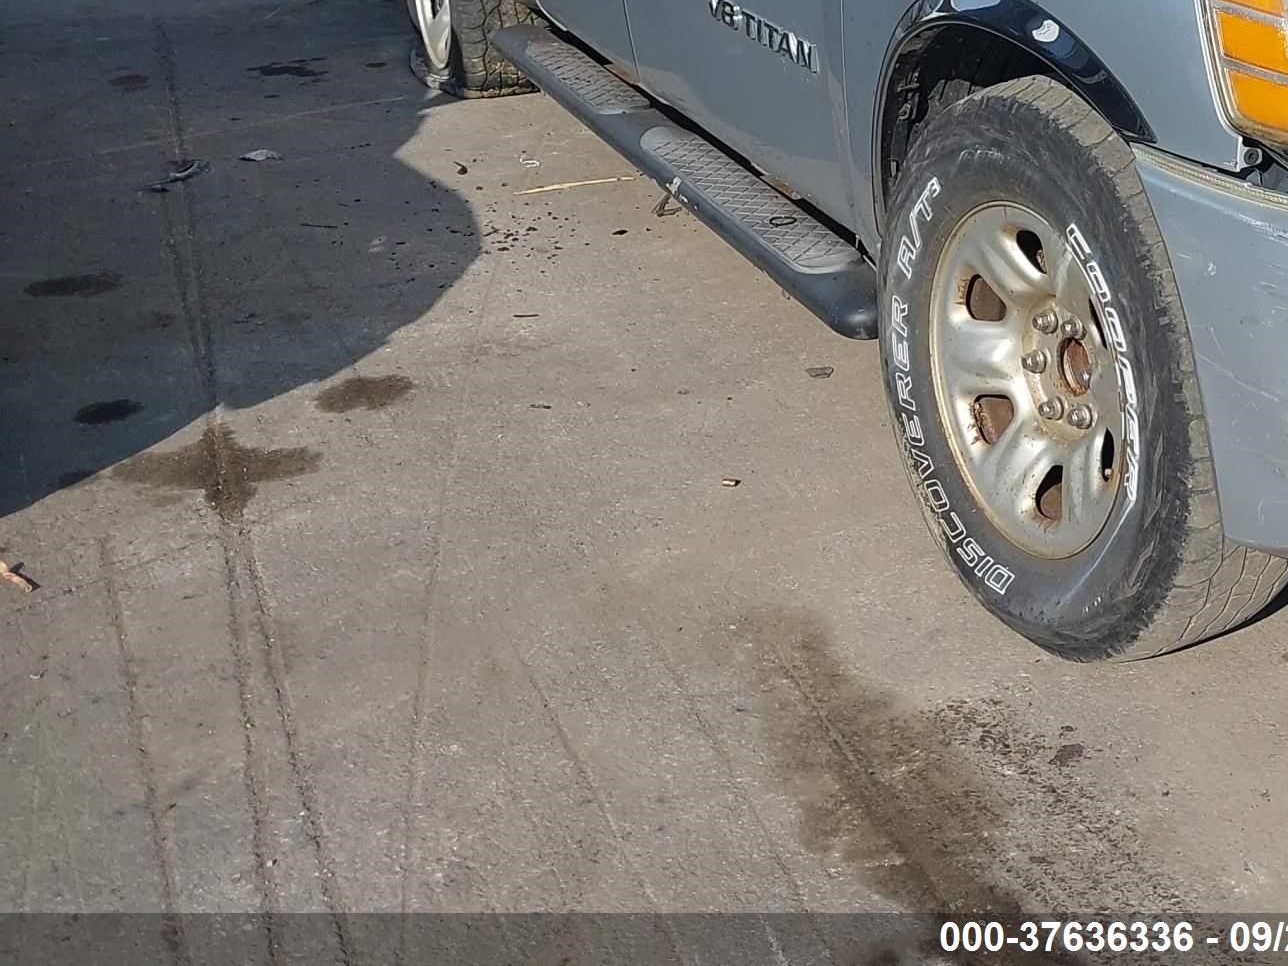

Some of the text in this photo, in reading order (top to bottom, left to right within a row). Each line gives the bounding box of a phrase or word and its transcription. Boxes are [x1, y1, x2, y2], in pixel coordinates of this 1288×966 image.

[741, 9, 819, 74] TITAN
[891, 295, 1015, 595] DISCOVERER
[1066, 223, 1140, 500] COOPER
